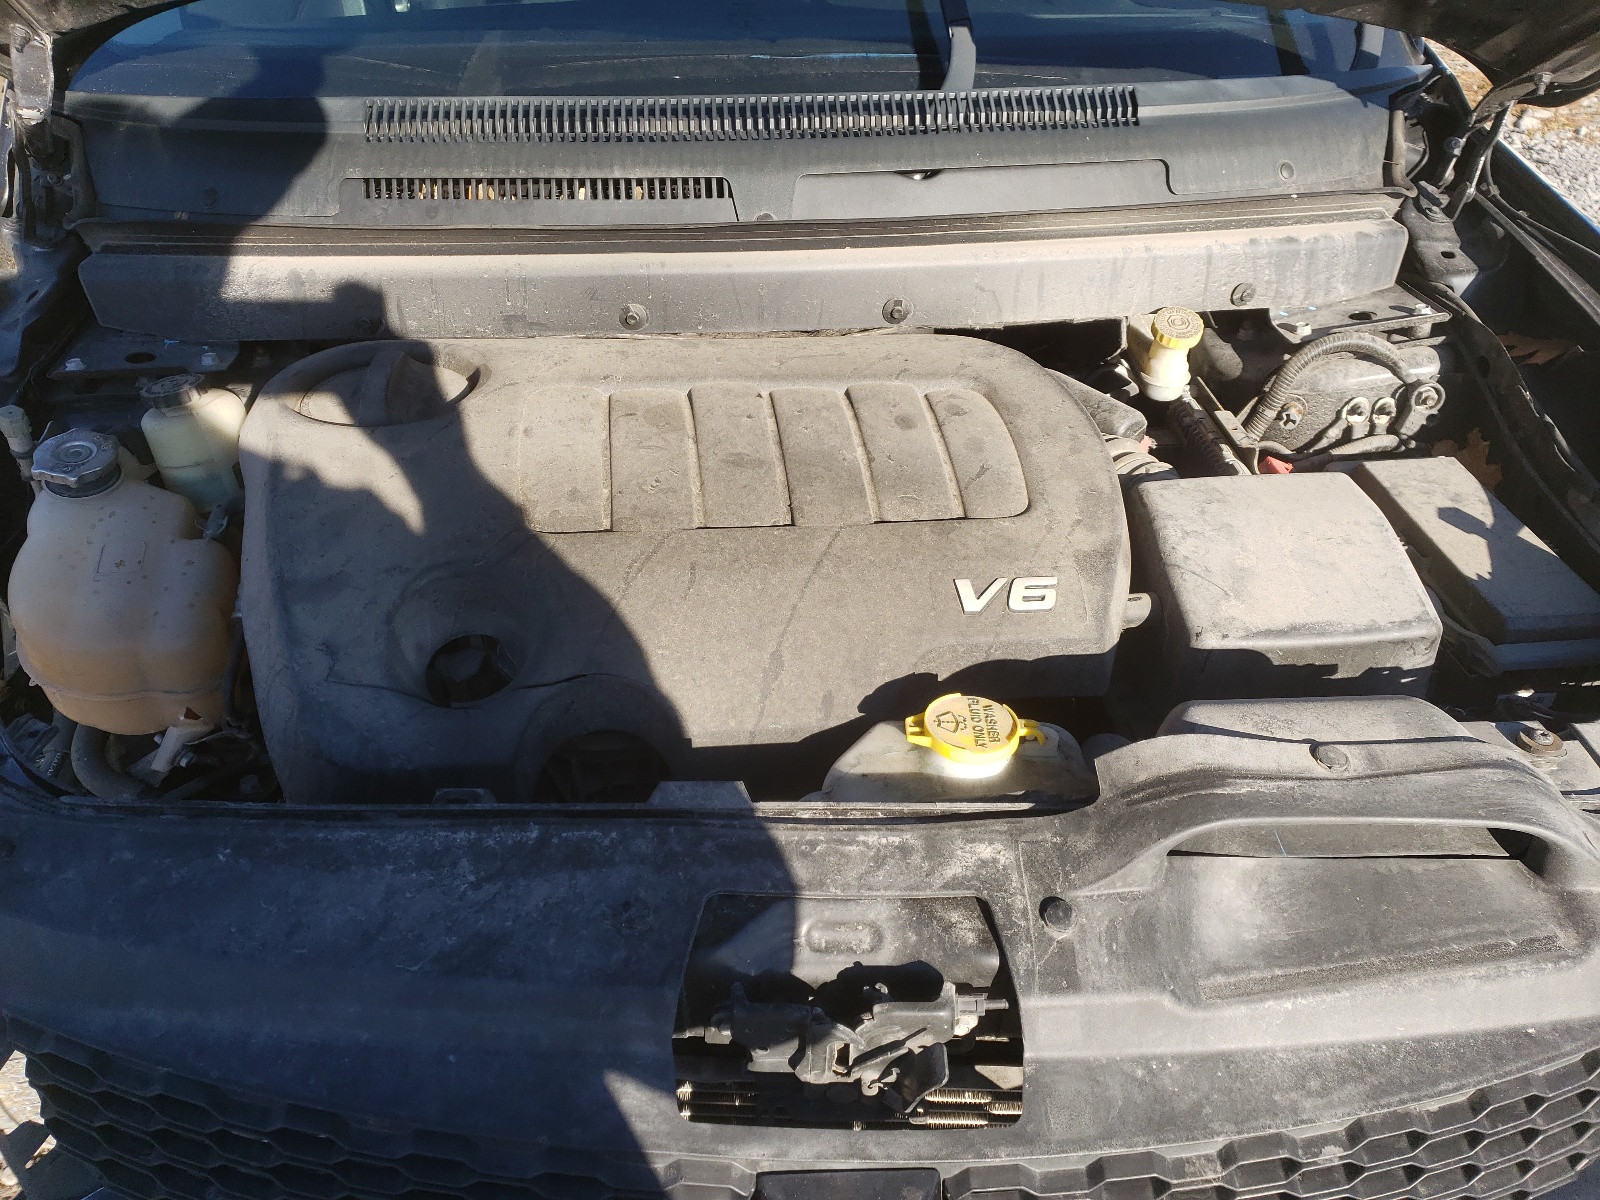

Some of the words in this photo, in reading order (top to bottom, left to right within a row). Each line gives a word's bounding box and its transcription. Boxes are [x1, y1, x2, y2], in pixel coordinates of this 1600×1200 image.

[953, 576, 1058, 615] V6
[967, 697, 982, 724] FLUID
[982, 704, 1001, 743] WASHER
[972, 725, 988, 748] ONLY
